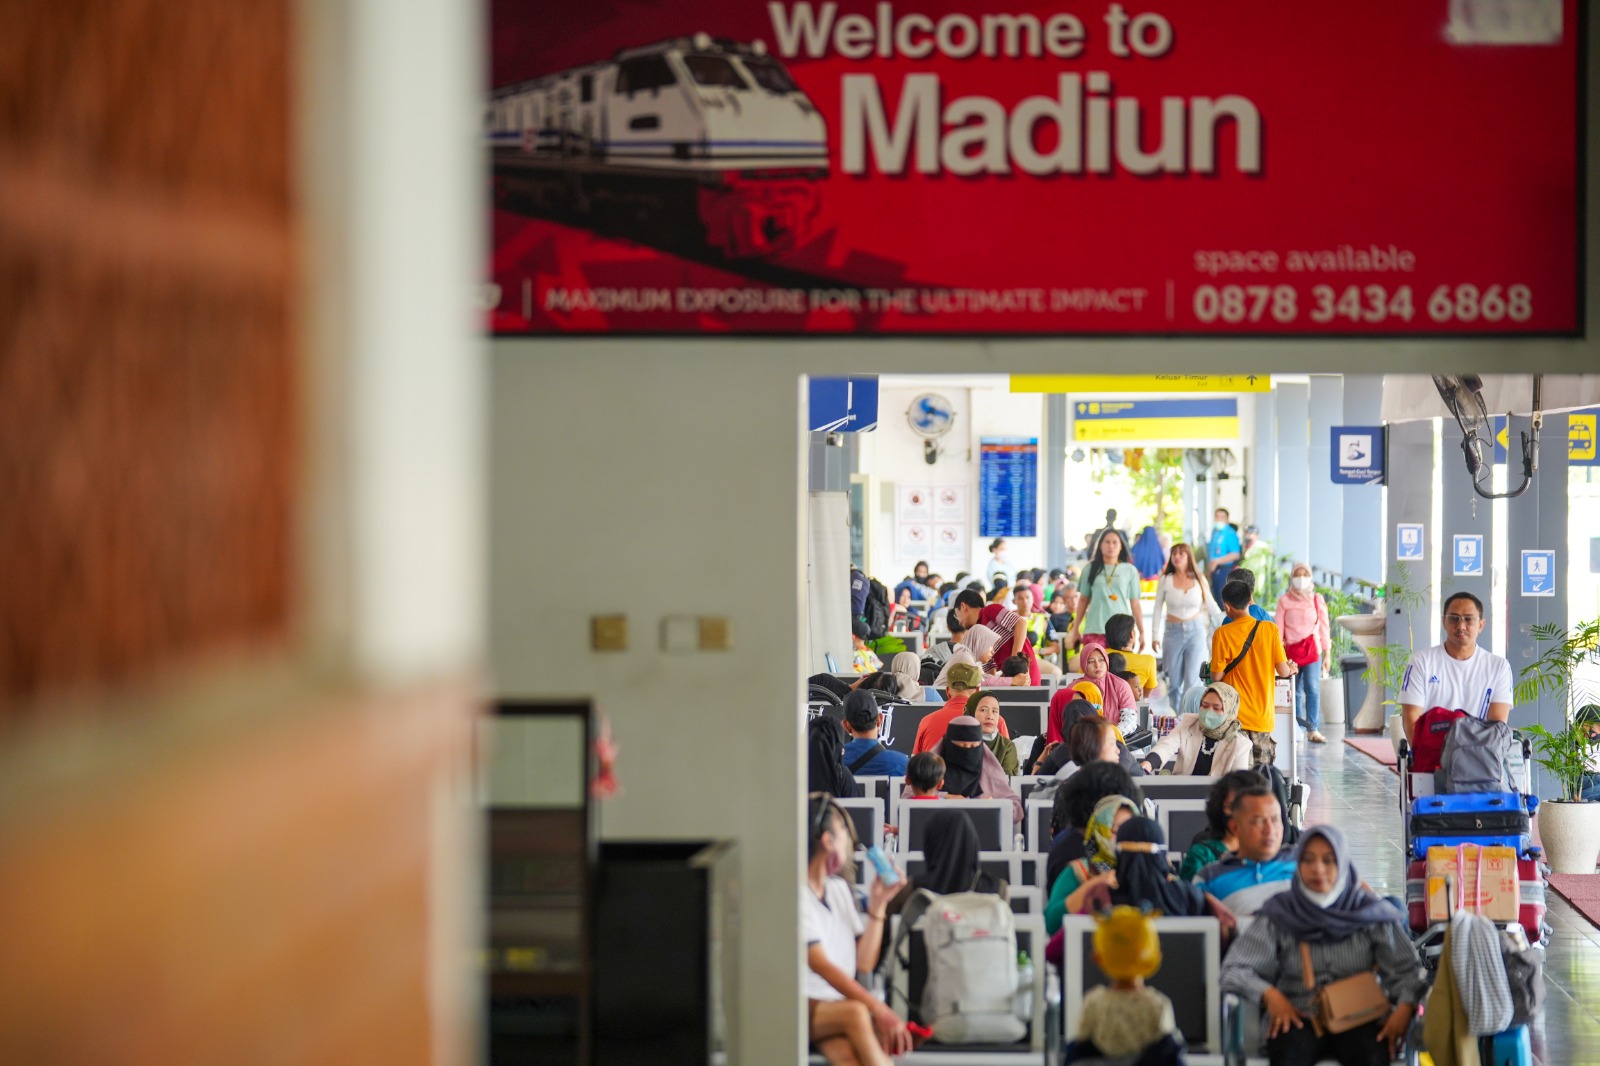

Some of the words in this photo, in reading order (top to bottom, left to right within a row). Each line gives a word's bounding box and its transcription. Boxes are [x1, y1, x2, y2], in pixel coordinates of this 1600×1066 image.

[767, 2, 1085, 58] Welcome
[1103, 3, 1172, 58] to
[841, 71, 1260, 175] Madiun
[1193, 249, 1279, 277] space
[1285, 244, 1416, 273] available
[544, 288, 672, 312] MAXIMUM
[675, 287, 805, 313] EXPOSURE
[809, 288, 862, 312] FOR
[866, 288, 917, 312] THE
[921, 288, 1046, 312] ULTIMATE
[1052, 288, 1147, 311] IMPACT
[1193, 284, 1299, 322] 0878
[1309, 284, 1415, 322] 3434
[1426, 283, 1532, 322] 6868
